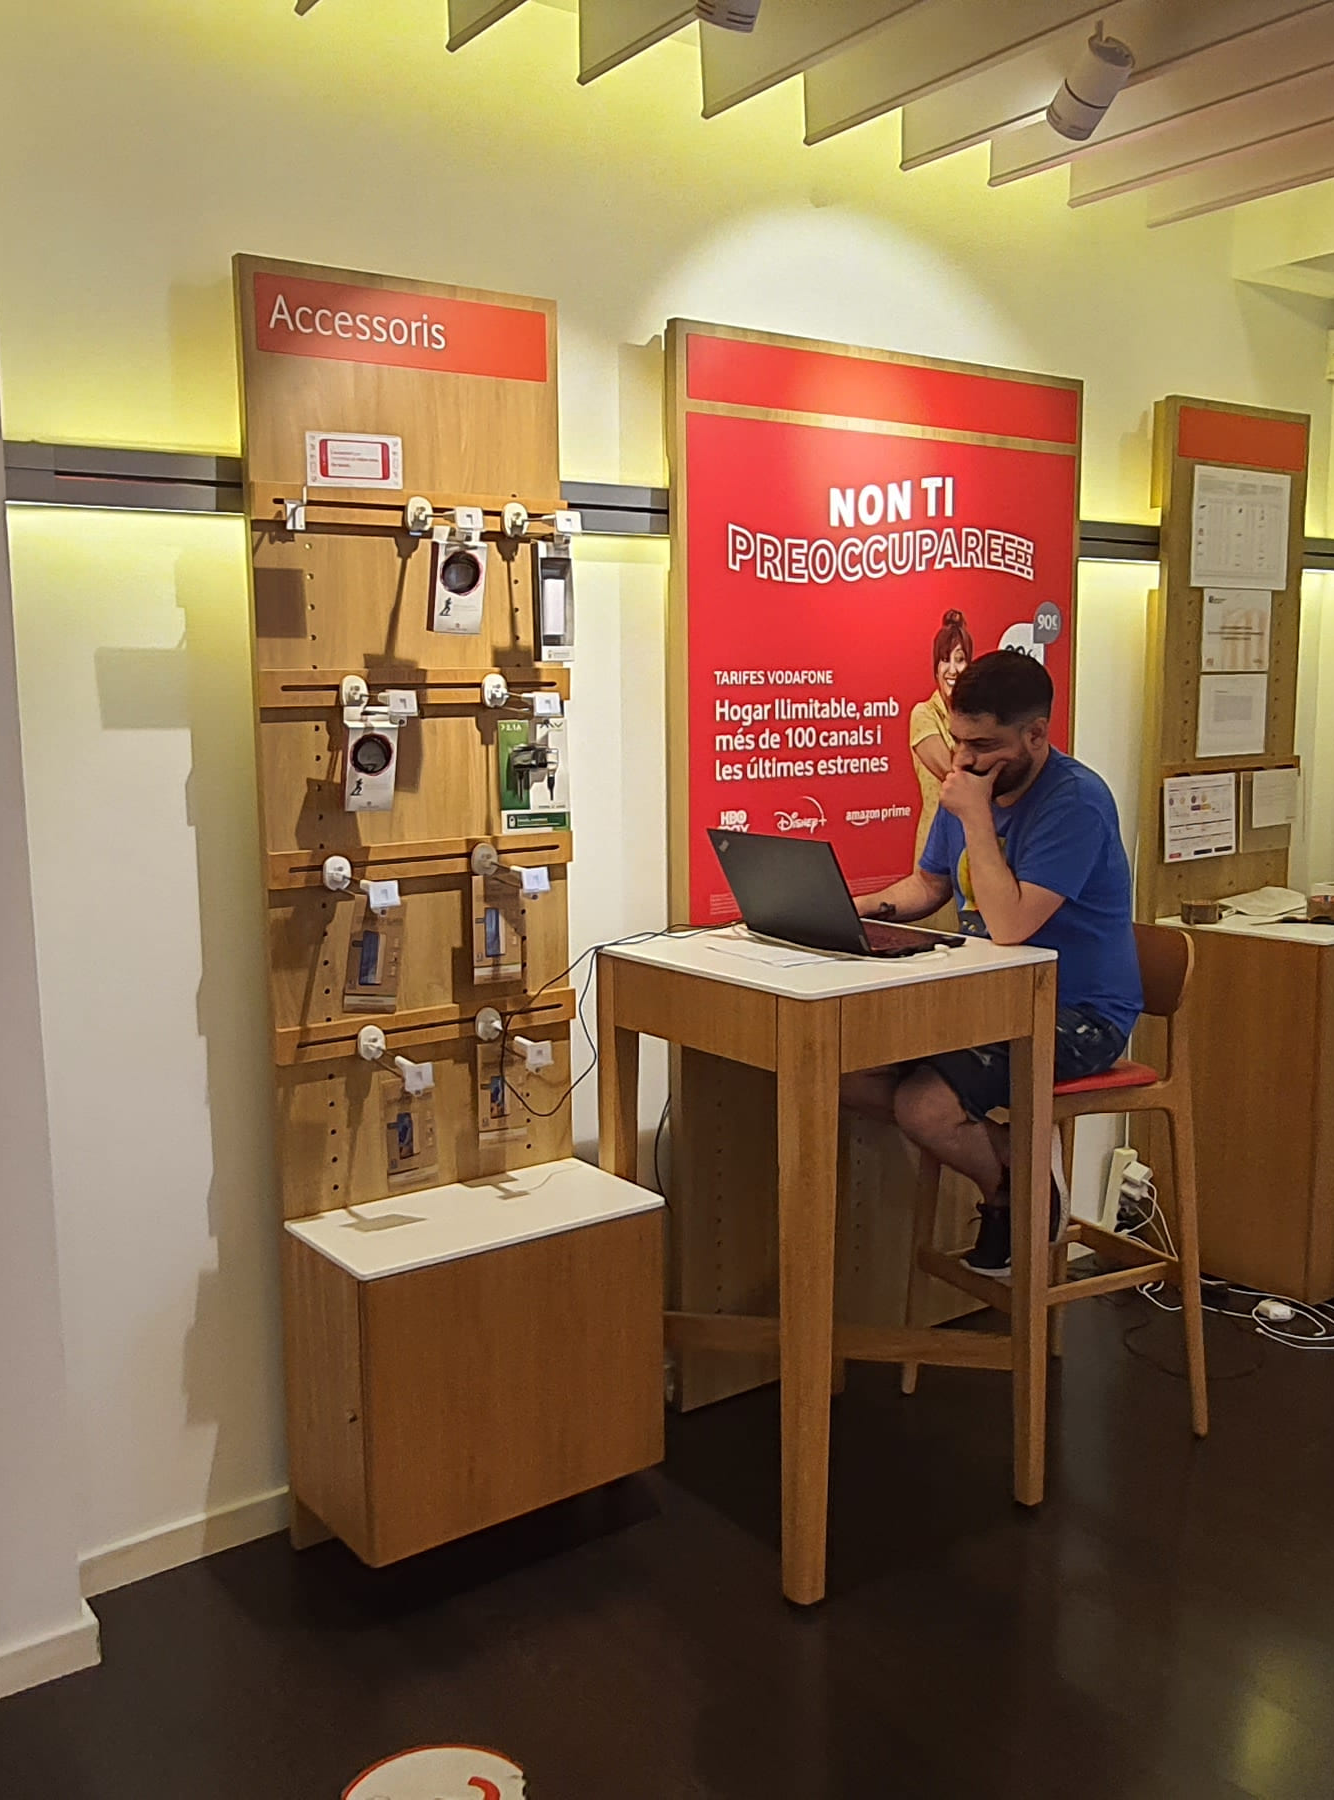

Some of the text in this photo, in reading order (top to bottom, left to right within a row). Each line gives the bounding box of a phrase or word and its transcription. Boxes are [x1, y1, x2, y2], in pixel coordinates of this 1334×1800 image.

[268, 293, 447, 351] Accessoris
[828, 475, 954, 528] NON TI
[714, 669, 834, 686] TARIFES VODAFONE
[715, 698, 772, 727] Hogar
[863, 695, 900, 718] amb
[715, 724, 882, 752] més de 100 canals i
[715, 754, 890, 782] les últimes estrenes
[720, 810, 748, 826] HBO
[845, 804, 912, 827] amazon prime
